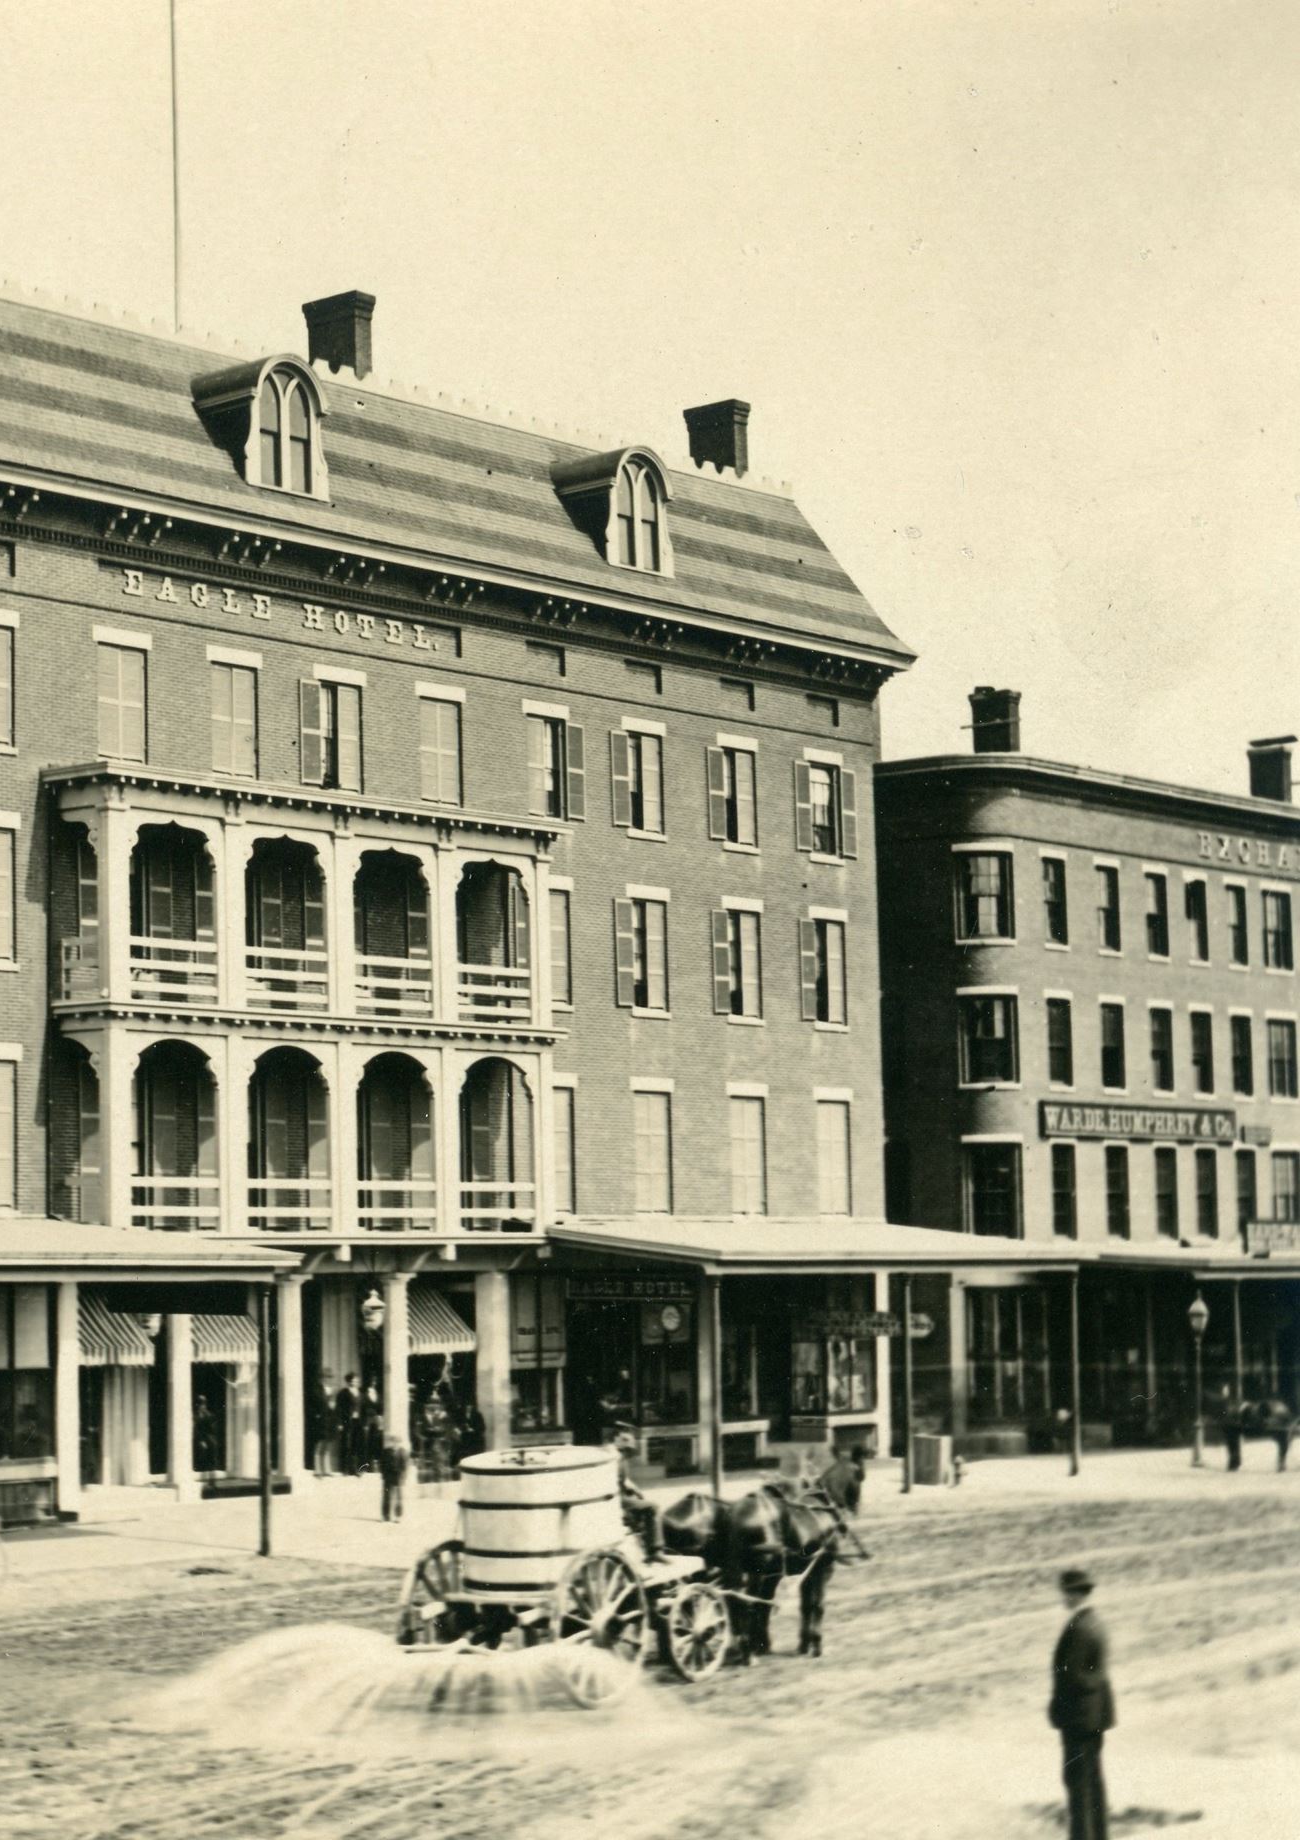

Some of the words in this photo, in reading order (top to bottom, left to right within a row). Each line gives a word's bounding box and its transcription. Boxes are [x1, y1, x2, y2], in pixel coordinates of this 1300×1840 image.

[123, 569, 273, 620] EAGLE
[1108, 1110, 1197, 1135] HUMPHREY
[1200, 1114, 1212, 1136] &
